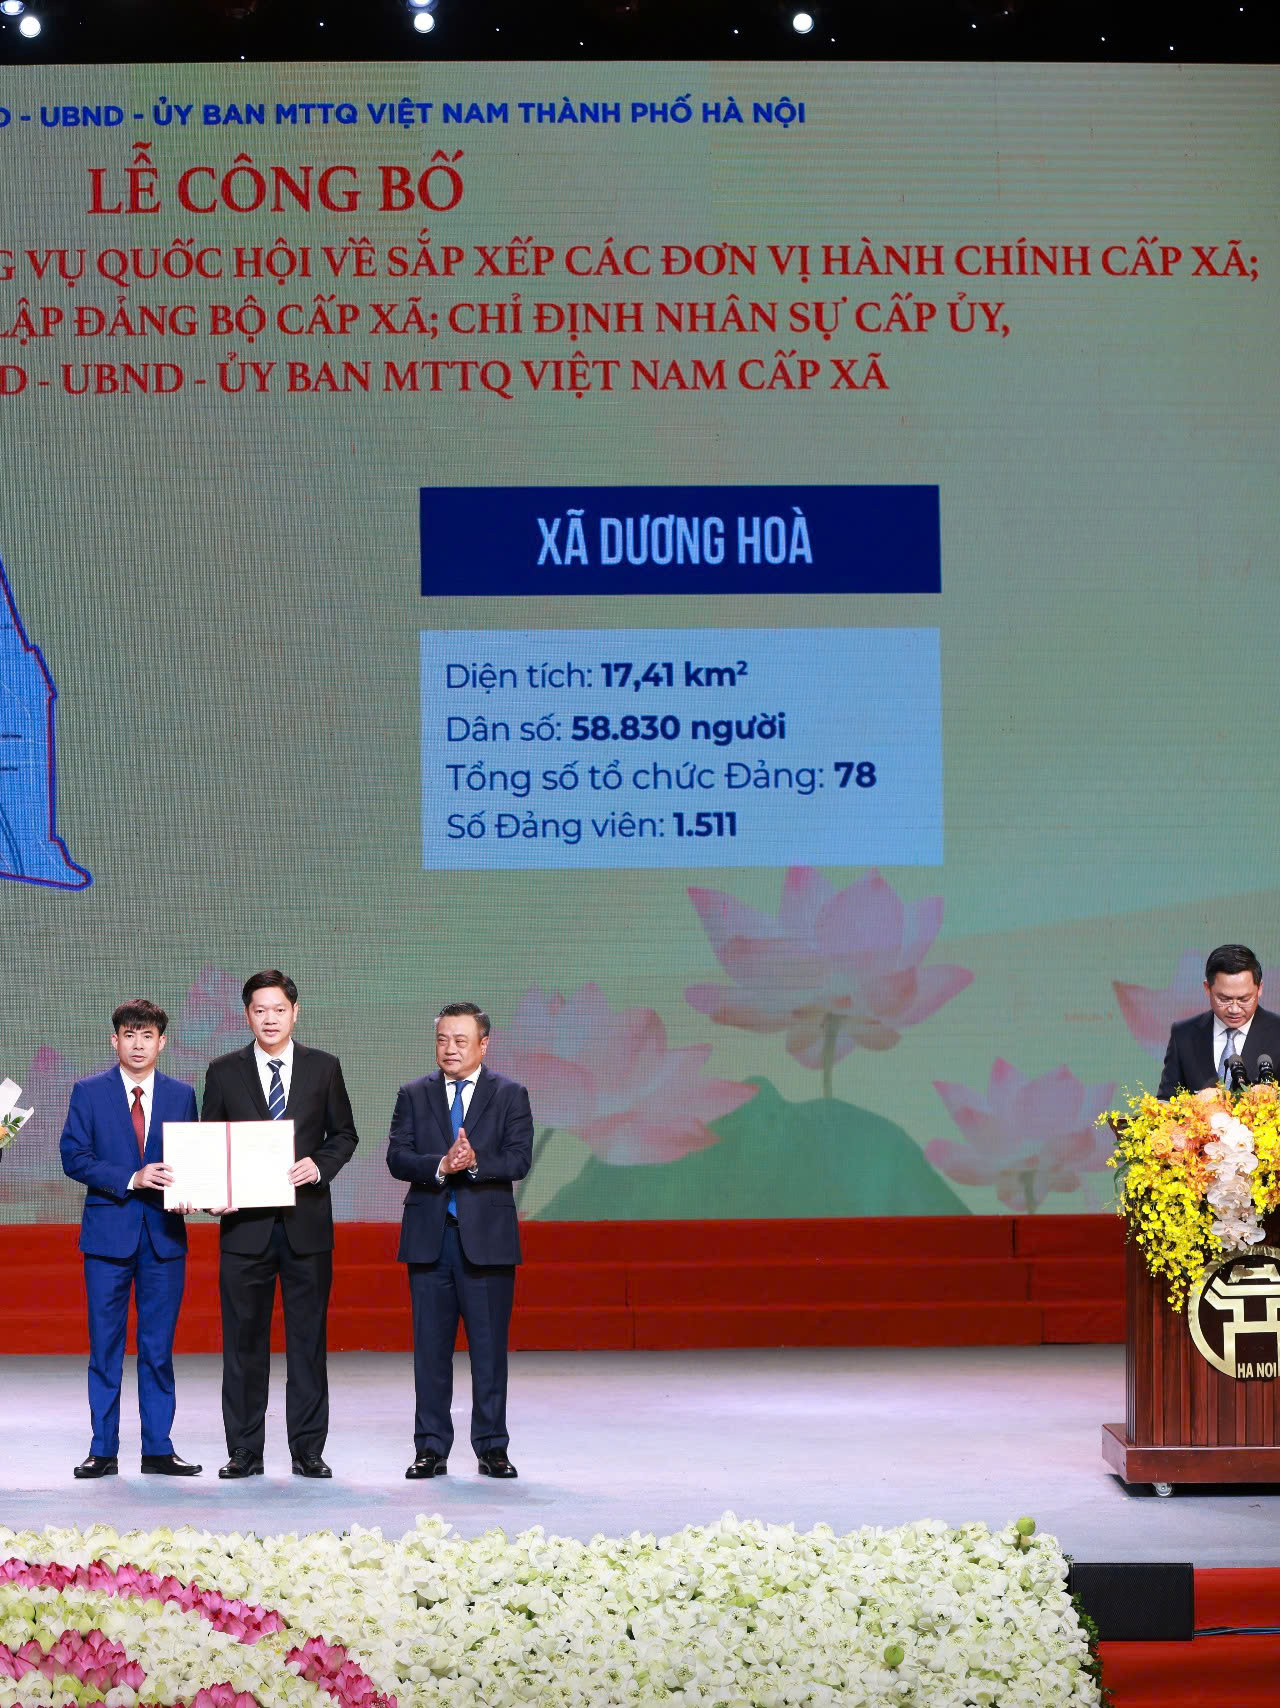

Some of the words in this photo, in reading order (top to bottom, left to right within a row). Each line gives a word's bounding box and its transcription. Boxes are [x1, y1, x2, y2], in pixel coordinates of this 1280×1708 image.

[40, 104, 124, 129] UBND
[153, 96, 193, 126] ỦY
[202, 103, 265, 126] BAN
[275, 102, 359, 125] MTTQ
[366, 97, 434, 129] VIỆT
[442, 102, 509, 124] NAM
[517, 97, 621, 124] THÀNH
[631, 94, 694, 124] PHỐ
[701, 96, 744, 123] HÀ
[752, 96, 806, 128] NỘI
[87, 140, 162, 215] LỄ
[176, 152, 361, 214] CÔNG
[377, 149, 465, 213] BỐ
[25, 248, 87, 289] VỤ
[96, 237, 224, 289] QUỐC
[233, 236, 312, 287] HỘI
[321, 236, 378, 278] VỀ
[387, 228, 466, 278] SẮP
[474, 235, 556, 277] XẾP
[564, 236, 652, 277] CÁC
[661, 241, 757, 277] ĐƠN
[767, 244, 811, 284] VỊ
[821, 236, 945, 276] HÀNH
[954, 236, 1091, 277] CHÍNH
[1100, 235, 1184, 278] CẤP
[1191, 239, 1260, 282] XÃ;
[73, 295, 198, 338] ĐẢNG
[209, 293, 268, 344] BỘ
[276, 293, 361, 336] CẤP
[369, 295, 440, 339] XÃ;
[447, 292, 522, 335] CHỈ
[533, 301, 644, 342] ĐỊNH
[655, 293, 778, 334] NHÂN
[788, 296, 849, 342] SỰ
[854, 291, 937, 333] CẤP
[947, 291, 1011, 337] ỦY,
[61, 362, 185, 396] UBND
[217, 351, 276, 394] ỦY
[287, 360, 371, 393] BAN
[383, 359, 514, 401] MTTQ
[520, 349, 622, 400] VIỆT
[631, 358, 727, 391] NAM
[737, 349, 822, 391] CẤP
[830, 351, 890, 391] XÃ
[537, 508, 589, 566] XÃ
[600, 513, 725, 566] DƯƠNG
[737, 506, 813, 565] HOÀ
[445, 662, 518, 695] Diện
[525, 661, 593, 689] tích:
[600, 661, 675, 693] 17,41
[446, 715, 511, 743] Dân
[519, 712, 562, 742] số:
[570, 713, 682, 742] 58.830
[690, 710, 787, 747] người
[444, 759, 532, 799] Tổng
[541, 759, 580, 791] số
[587, 758, 624, 791] tổ
[631, 760, 716, 791] chức
[723, 758, 825, 796] Đảng:
[833, 760, 878, 789] 78
[446, 809, 487, 840] Số
[494, 809, 583, 846] Đảng
[590, 810, 665, 839] viên:
[672, 810, 738, 838] 1.511
[1237, 1362, 1254, 1378] HA
[1257, 1362, 1277, 1378] NOI
